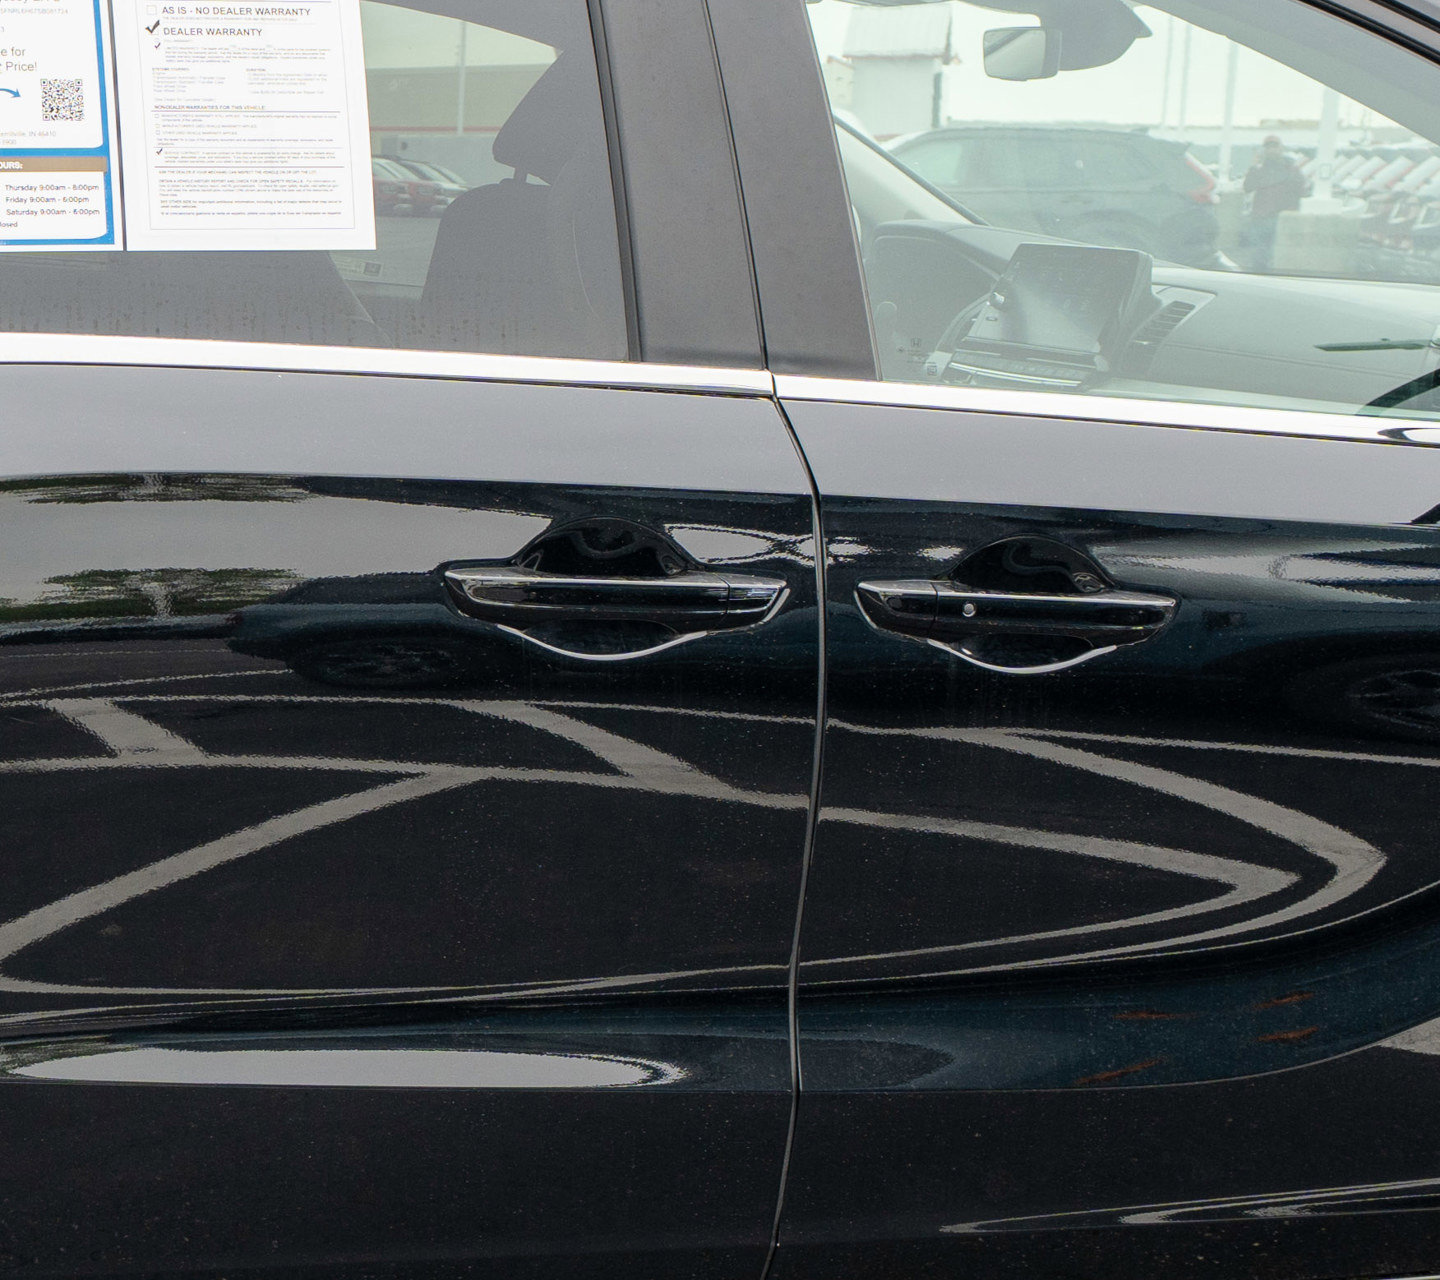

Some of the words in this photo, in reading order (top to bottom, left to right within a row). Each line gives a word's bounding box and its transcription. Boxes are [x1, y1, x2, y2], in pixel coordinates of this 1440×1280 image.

[162, 7, 175, 15] AS
[177, 7, 187, 15] IS
[195, 7, 210, 15] NO
[212, 7, 253, 16] DEALER
[254, 7, 311, 16] WARRANTY
[163, 27, 203, 36] DEALER
[205, 28, 263, 37] WARRANTY
[10, 46, 26, 57] for
[5, 61, 37, 72] Price!
[5, 184, 38, 192] Thursday
[5, 196, 28, 204] Friday
[6, 208, 38, 217] Saturday
